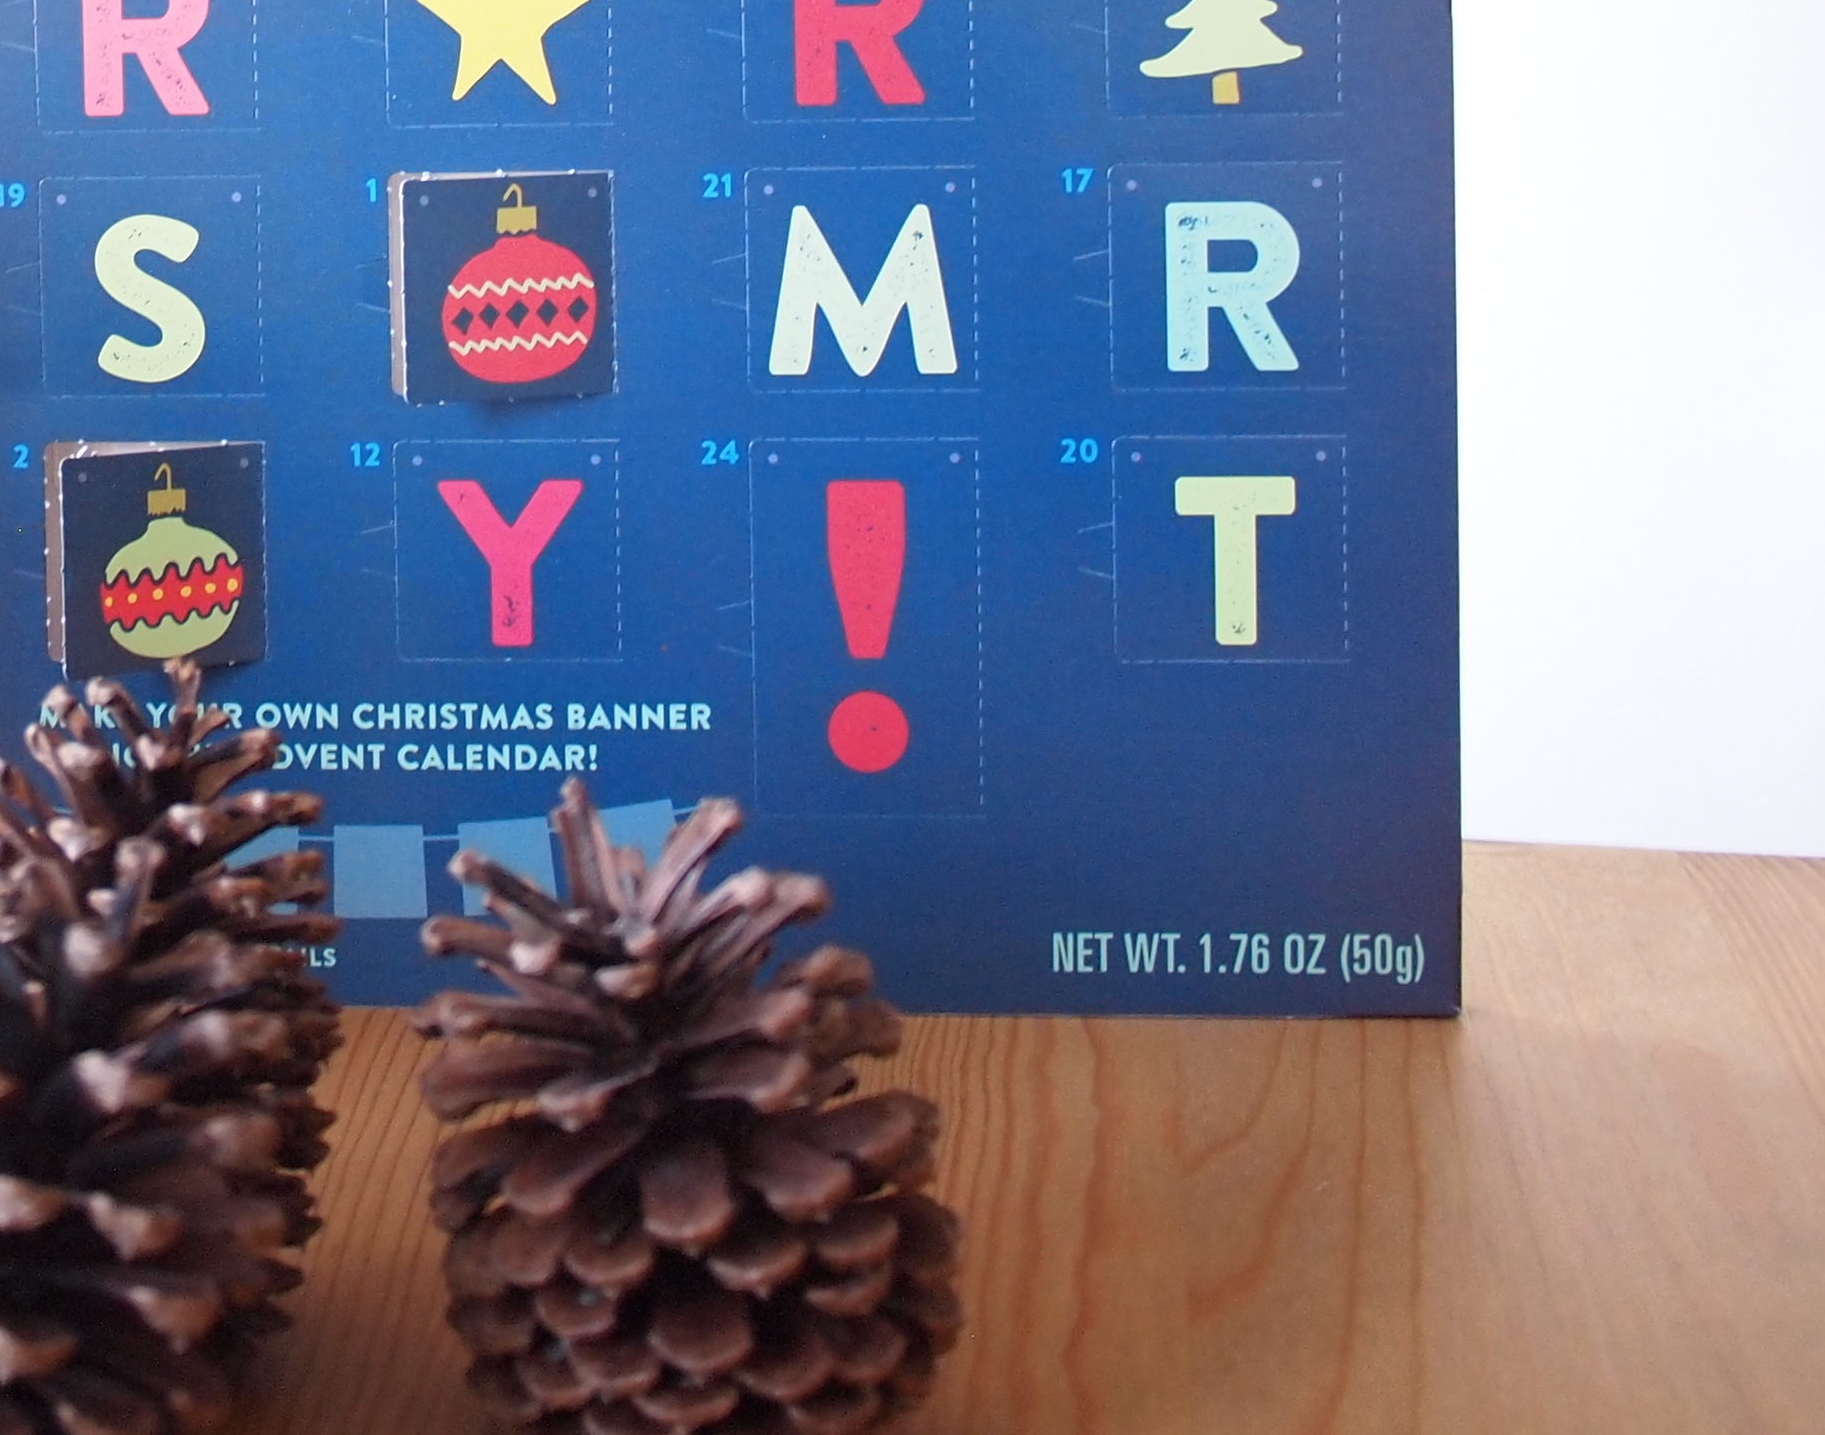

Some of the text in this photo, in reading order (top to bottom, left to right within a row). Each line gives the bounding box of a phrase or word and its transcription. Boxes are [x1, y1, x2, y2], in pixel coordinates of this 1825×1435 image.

[364, 176, 378, 204] 1
[701, 171, 733, 199] 21
[1060, 166, 1094, 194] 17
[93, 213, 207, 384] S
[768, 203, 959, 378] M
[1165, 201, 1301, 372] R
[12, 443, 30, 470] 2
[349, 441, 381, 468] 12
[700, 438, 741, 466] 24
[1059, 437, 1100, 464] 20
[437, 478, 584, 647] Y
[1174, 475, 1297, 646] T
[826, 480, 909, 773] !
[255, 701, 339, 730] OWN
[352, 702, 554, 731] CHRISTMAS
[567, 702, 712, 732] BANNER
[271, 743, 599, 772] DVENT CALENDAR!
[1051, 931, 1425, 986] NET WT. 1.76 OZ (50g)
